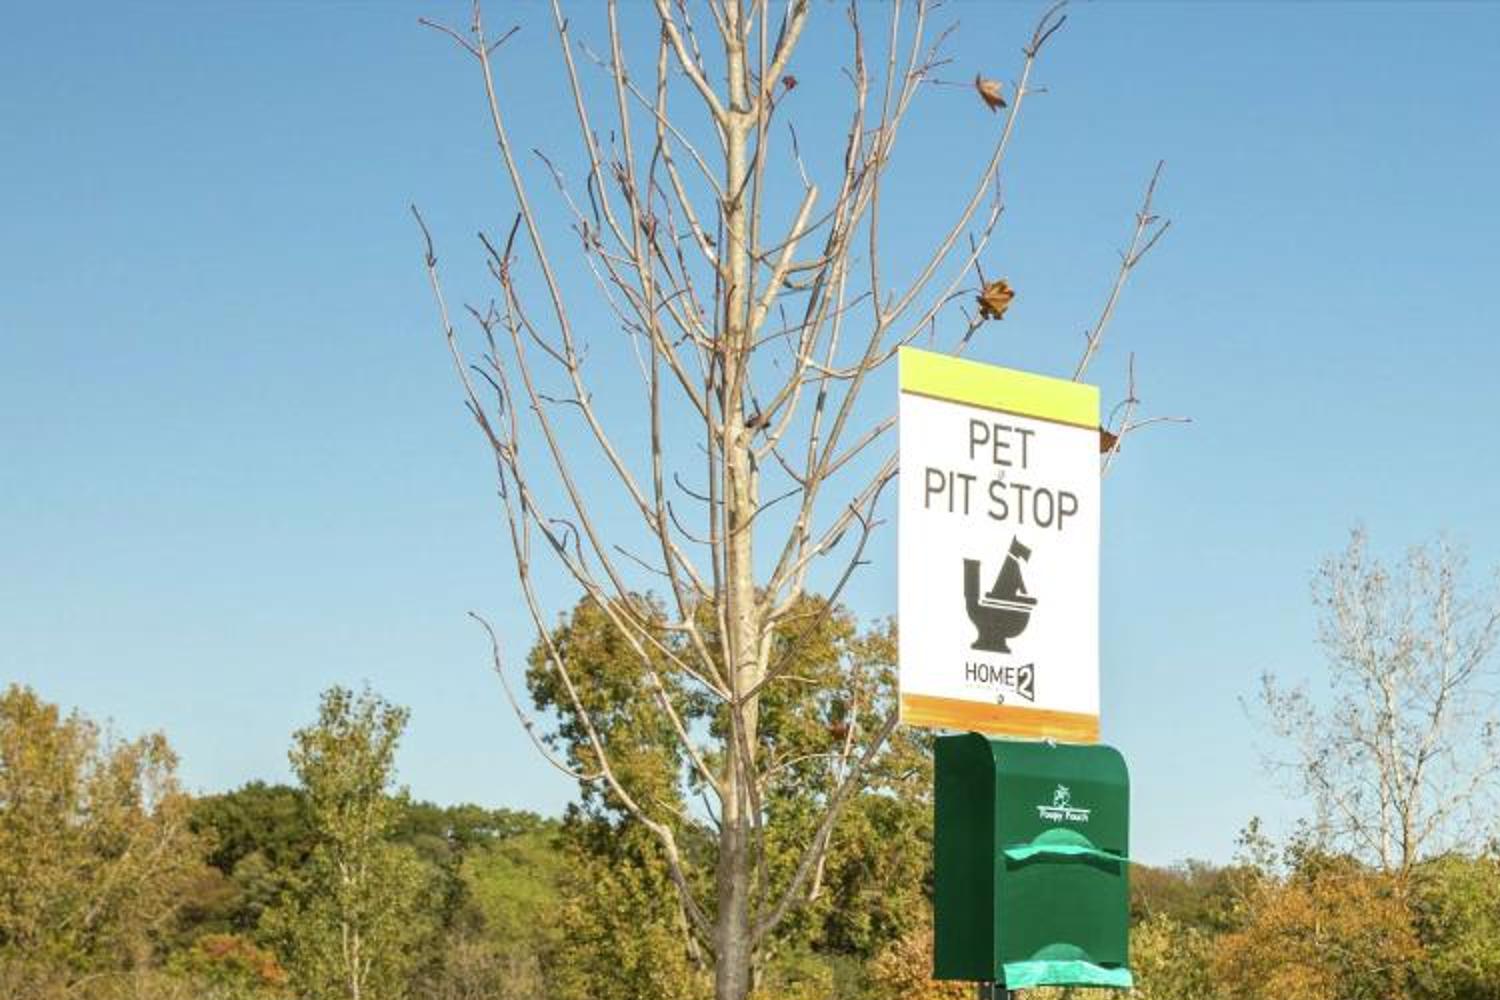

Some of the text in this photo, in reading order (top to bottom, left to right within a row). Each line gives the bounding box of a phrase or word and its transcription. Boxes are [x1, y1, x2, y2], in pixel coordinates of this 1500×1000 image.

[969, 419, 1034, 469] PET
[925, 467, 1079, 531] PIT STOP
